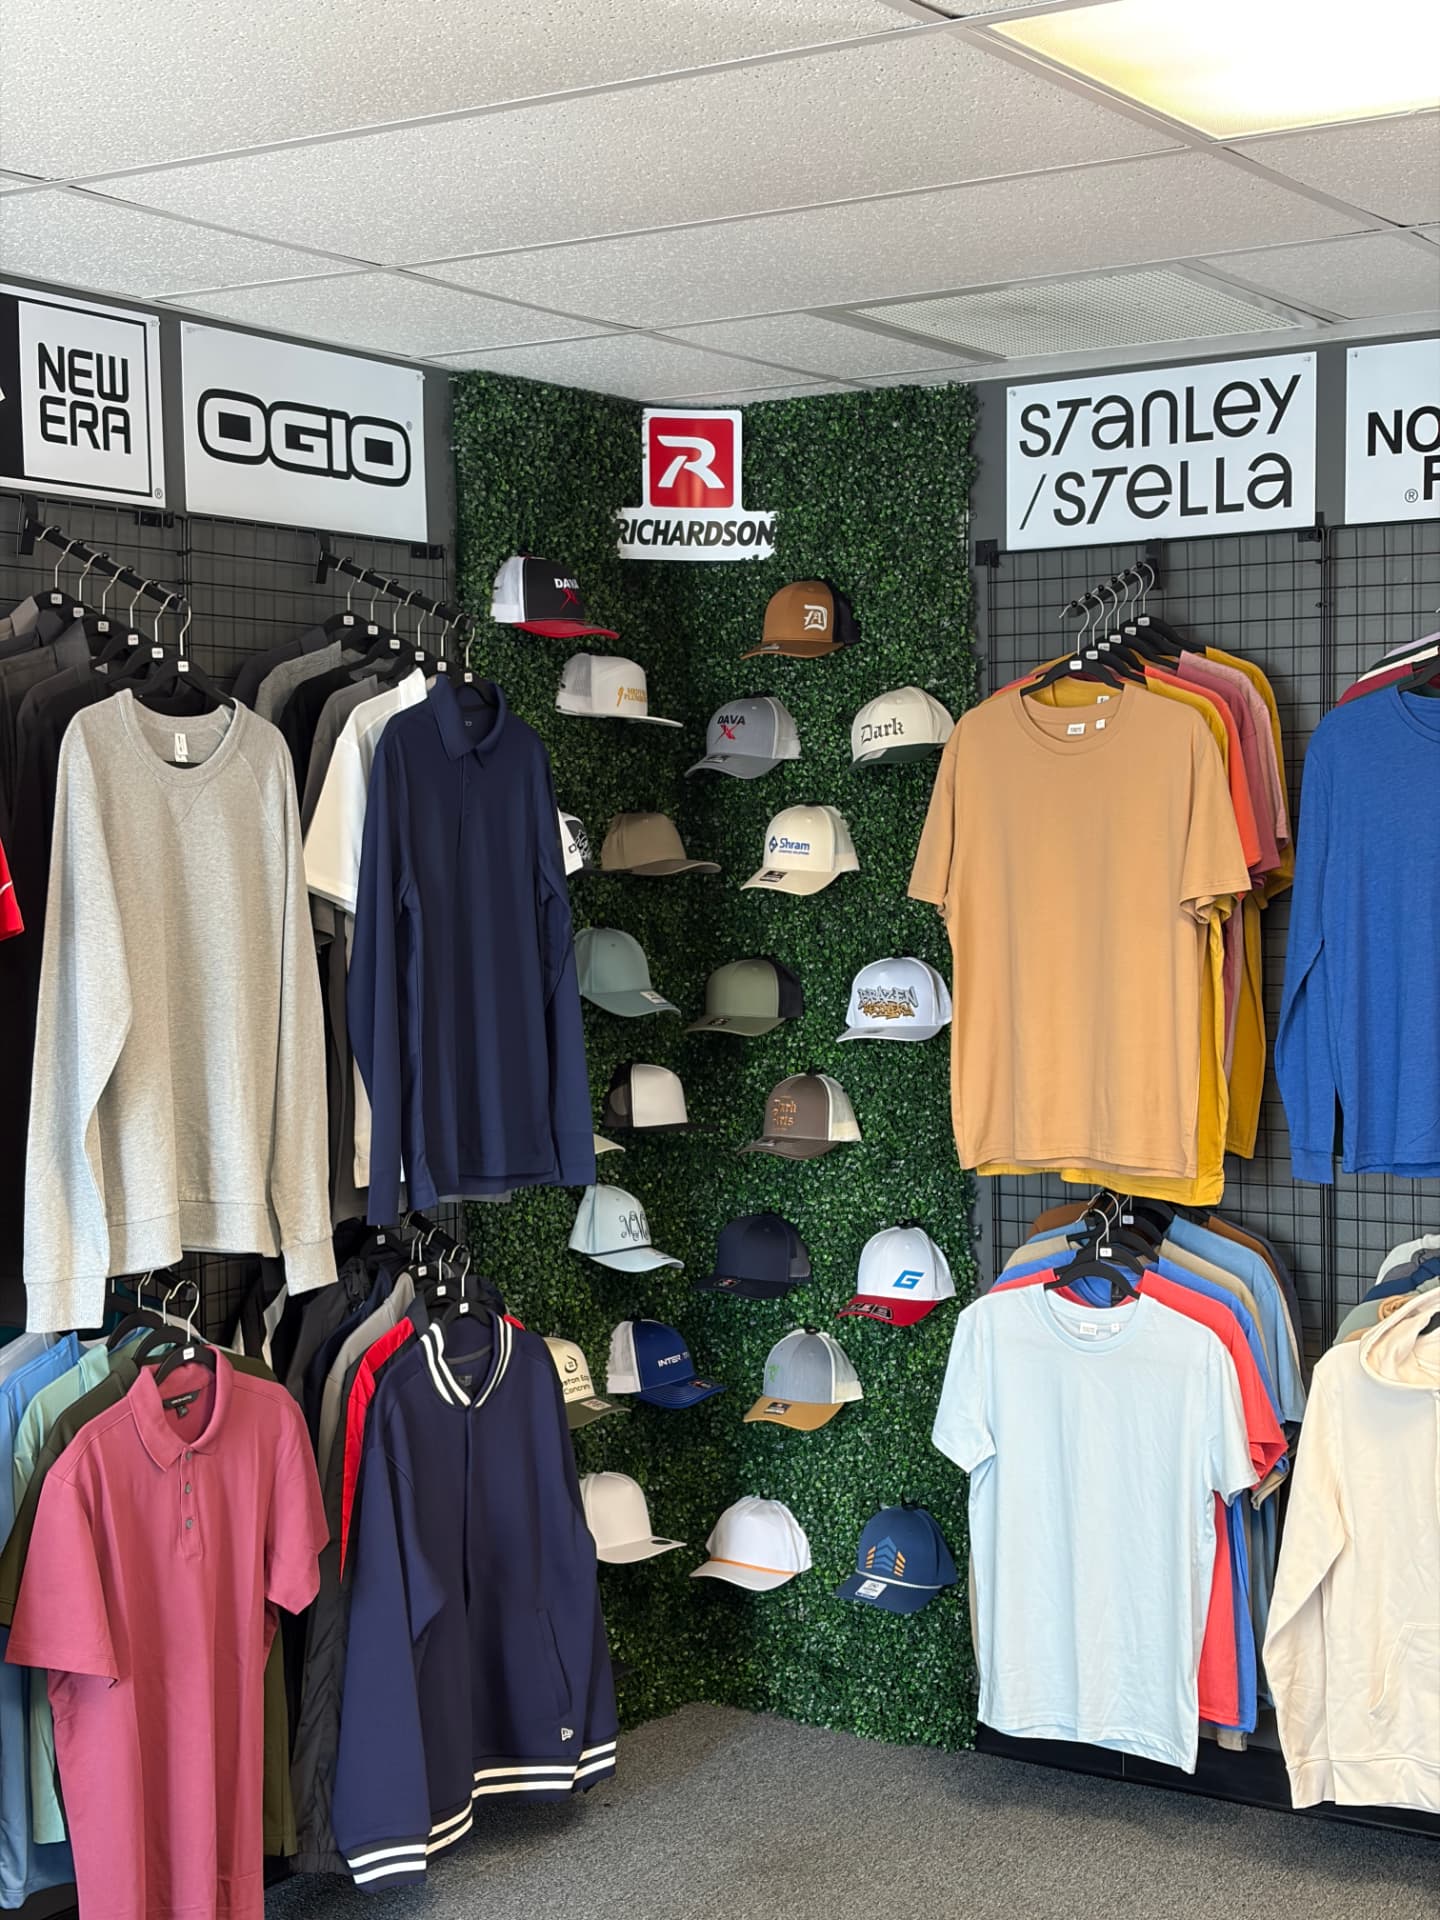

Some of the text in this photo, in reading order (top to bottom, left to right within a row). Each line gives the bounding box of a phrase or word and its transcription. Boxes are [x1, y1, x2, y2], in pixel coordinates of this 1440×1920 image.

[37, 341, 129, 403] NEW
[39, 394, 131, 455] ERA
[197, 388, 411, 487] OGIO
[617, 518, 776, 547] RICHARDSON
[717, 714, 746, 726] DAVA
[861, 717, 904, 746] Dark
[779, 837, 811, 852] Shram
[892, 1269, 925, 1291] G
